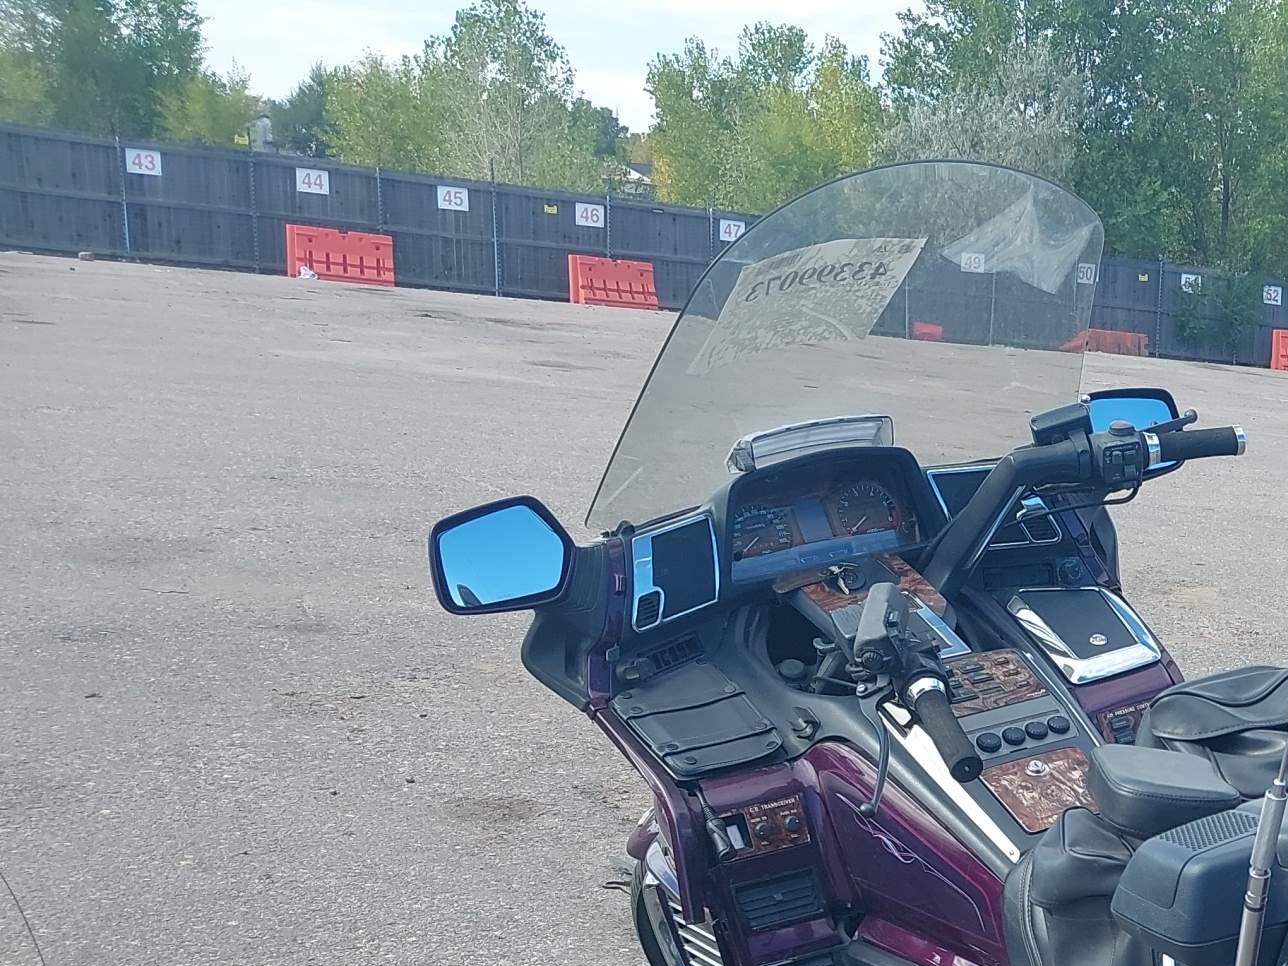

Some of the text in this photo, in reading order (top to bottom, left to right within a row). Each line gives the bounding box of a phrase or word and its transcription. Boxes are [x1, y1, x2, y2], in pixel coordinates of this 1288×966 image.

[132, 153, 156, 171] 43
[303, 172, 324, 190] 44
[443, 190, 464, 207] 45
[580, 207, 600, 223] 46
[724, 223, 741, 239] 47
[964, 256, 979, 270] 49
[1078, 266, 1093, 281] 50
[1265, 288, 1279, 303] 52
